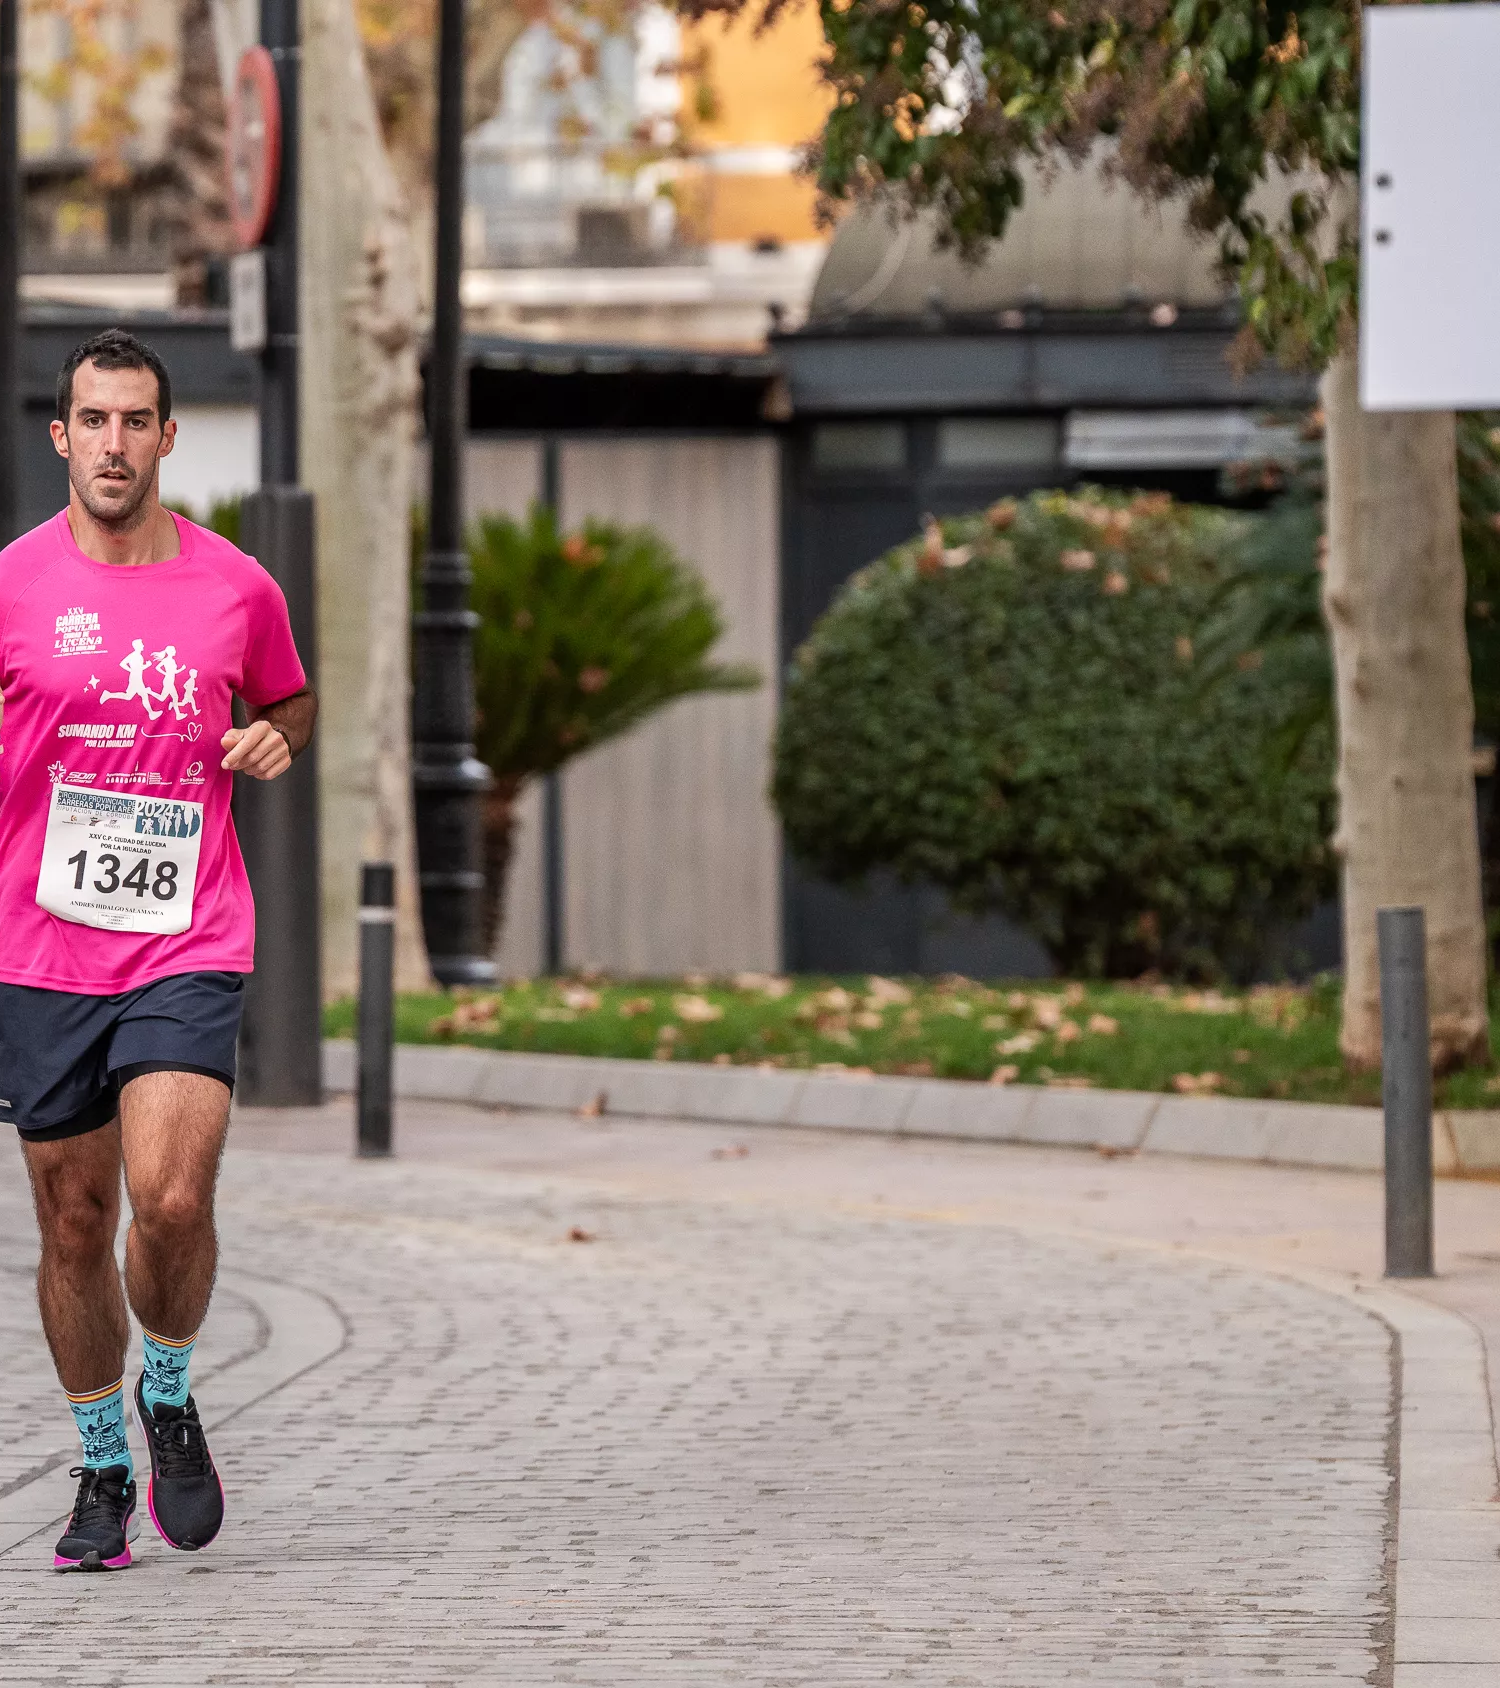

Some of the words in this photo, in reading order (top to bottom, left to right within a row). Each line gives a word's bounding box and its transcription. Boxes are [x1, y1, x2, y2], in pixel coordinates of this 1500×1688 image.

[67, 606, 83, 615] XXV
[55, 612, 99, 627] CARRERA
[54, 623, 101, 635] POPULAR
[54, 636, 103, 648] LUCENA
[58, 724, 115, 738] SUMANDO
[115, 724, 137, 739] KM
[84, 739, 97, 747] POR
[97, 739, 106, 747] LA
[57, 790, 87, 801] CIRCUITO
[88, 795, 123, 807] PROVINCIAL
[57, 797, 94, 809] CARRERAS
[95, 802, 136, 815] POPULARES
[136, 801, 174, 818] 2024
[88, 833, 102, 841] XXV
[102, 834, 113, 842] C.P.
[114, 836, 136, 845] CIUDAD
[145, 840, 167, 848] LUCENA
[122, 845, 152, 854] IGUALDAD
[67, 849, 179, 901] 1348
[95, 903, 124, 912] HIDALGO
[124, 906, 165, 916] SALAMANCA
